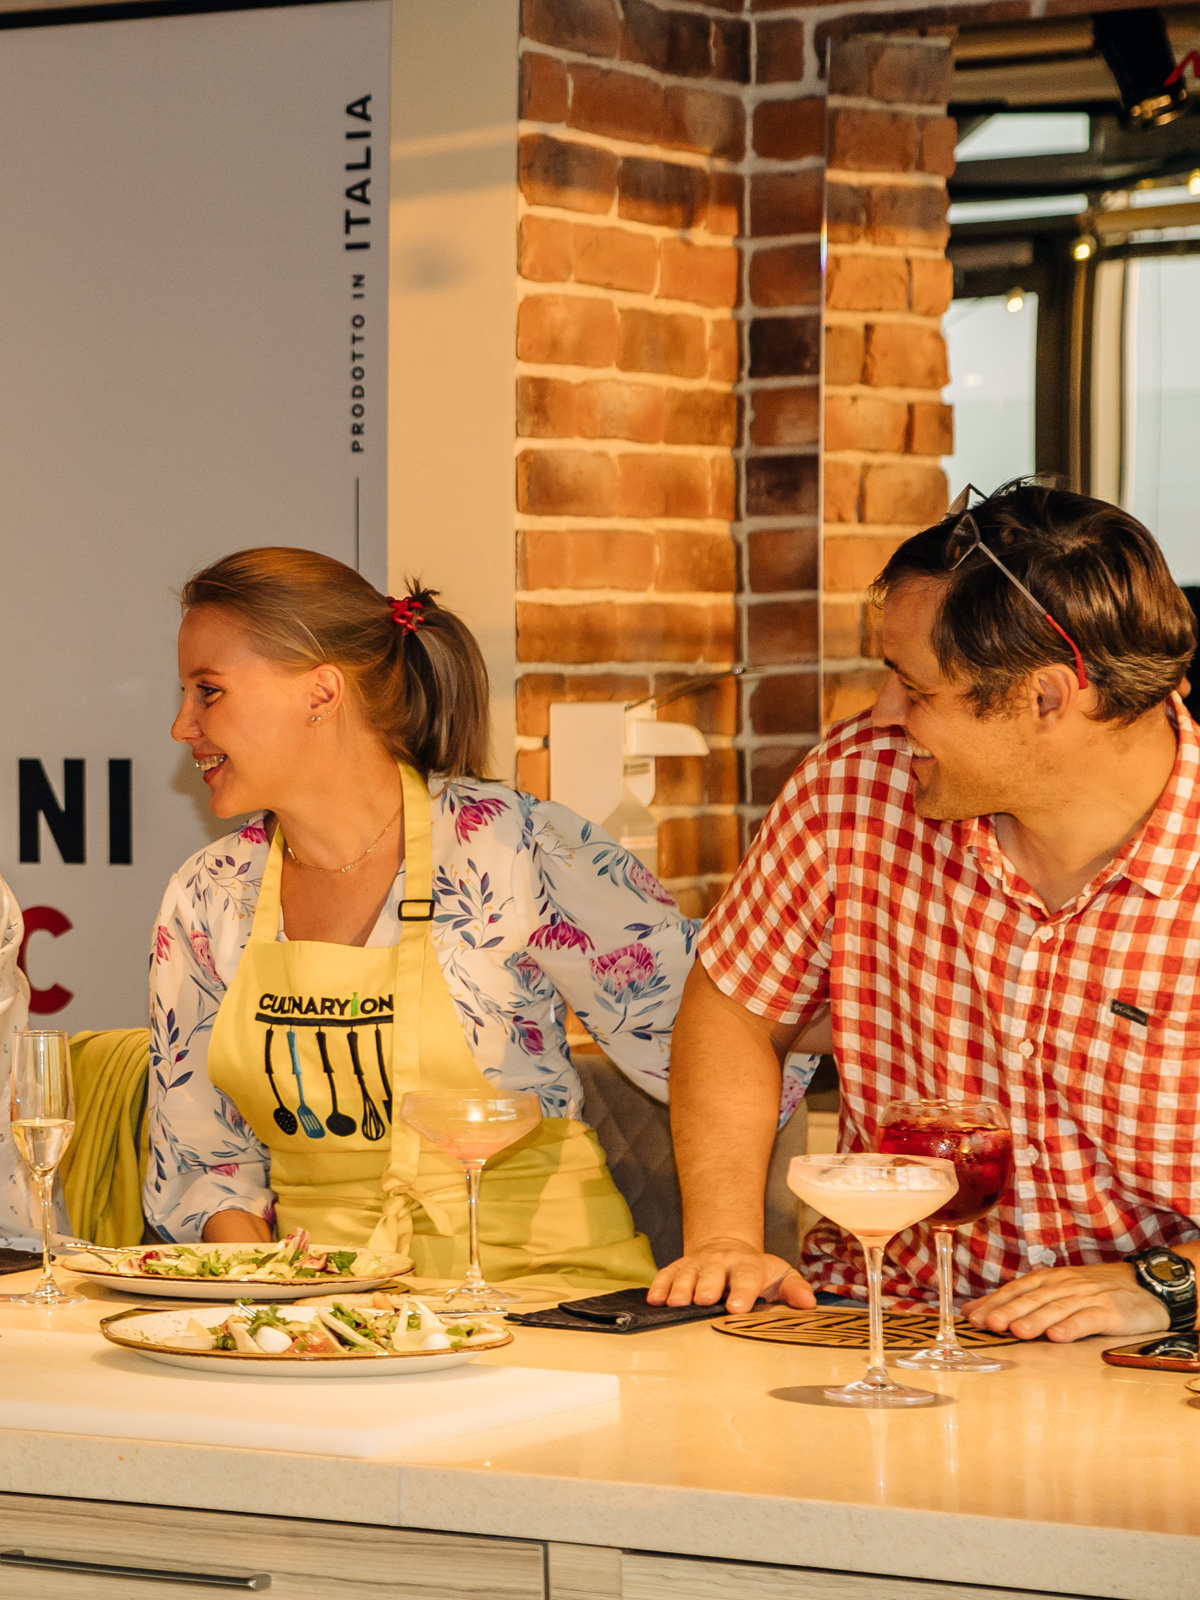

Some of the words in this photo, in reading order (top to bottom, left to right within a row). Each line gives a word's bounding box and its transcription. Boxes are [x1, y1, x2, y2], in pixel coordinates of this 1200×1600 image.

[345, 94, 373, 251] ITALIA
[351, 273, 366, 300] IN
[351, 314, 366, 454] PRODOTTO
